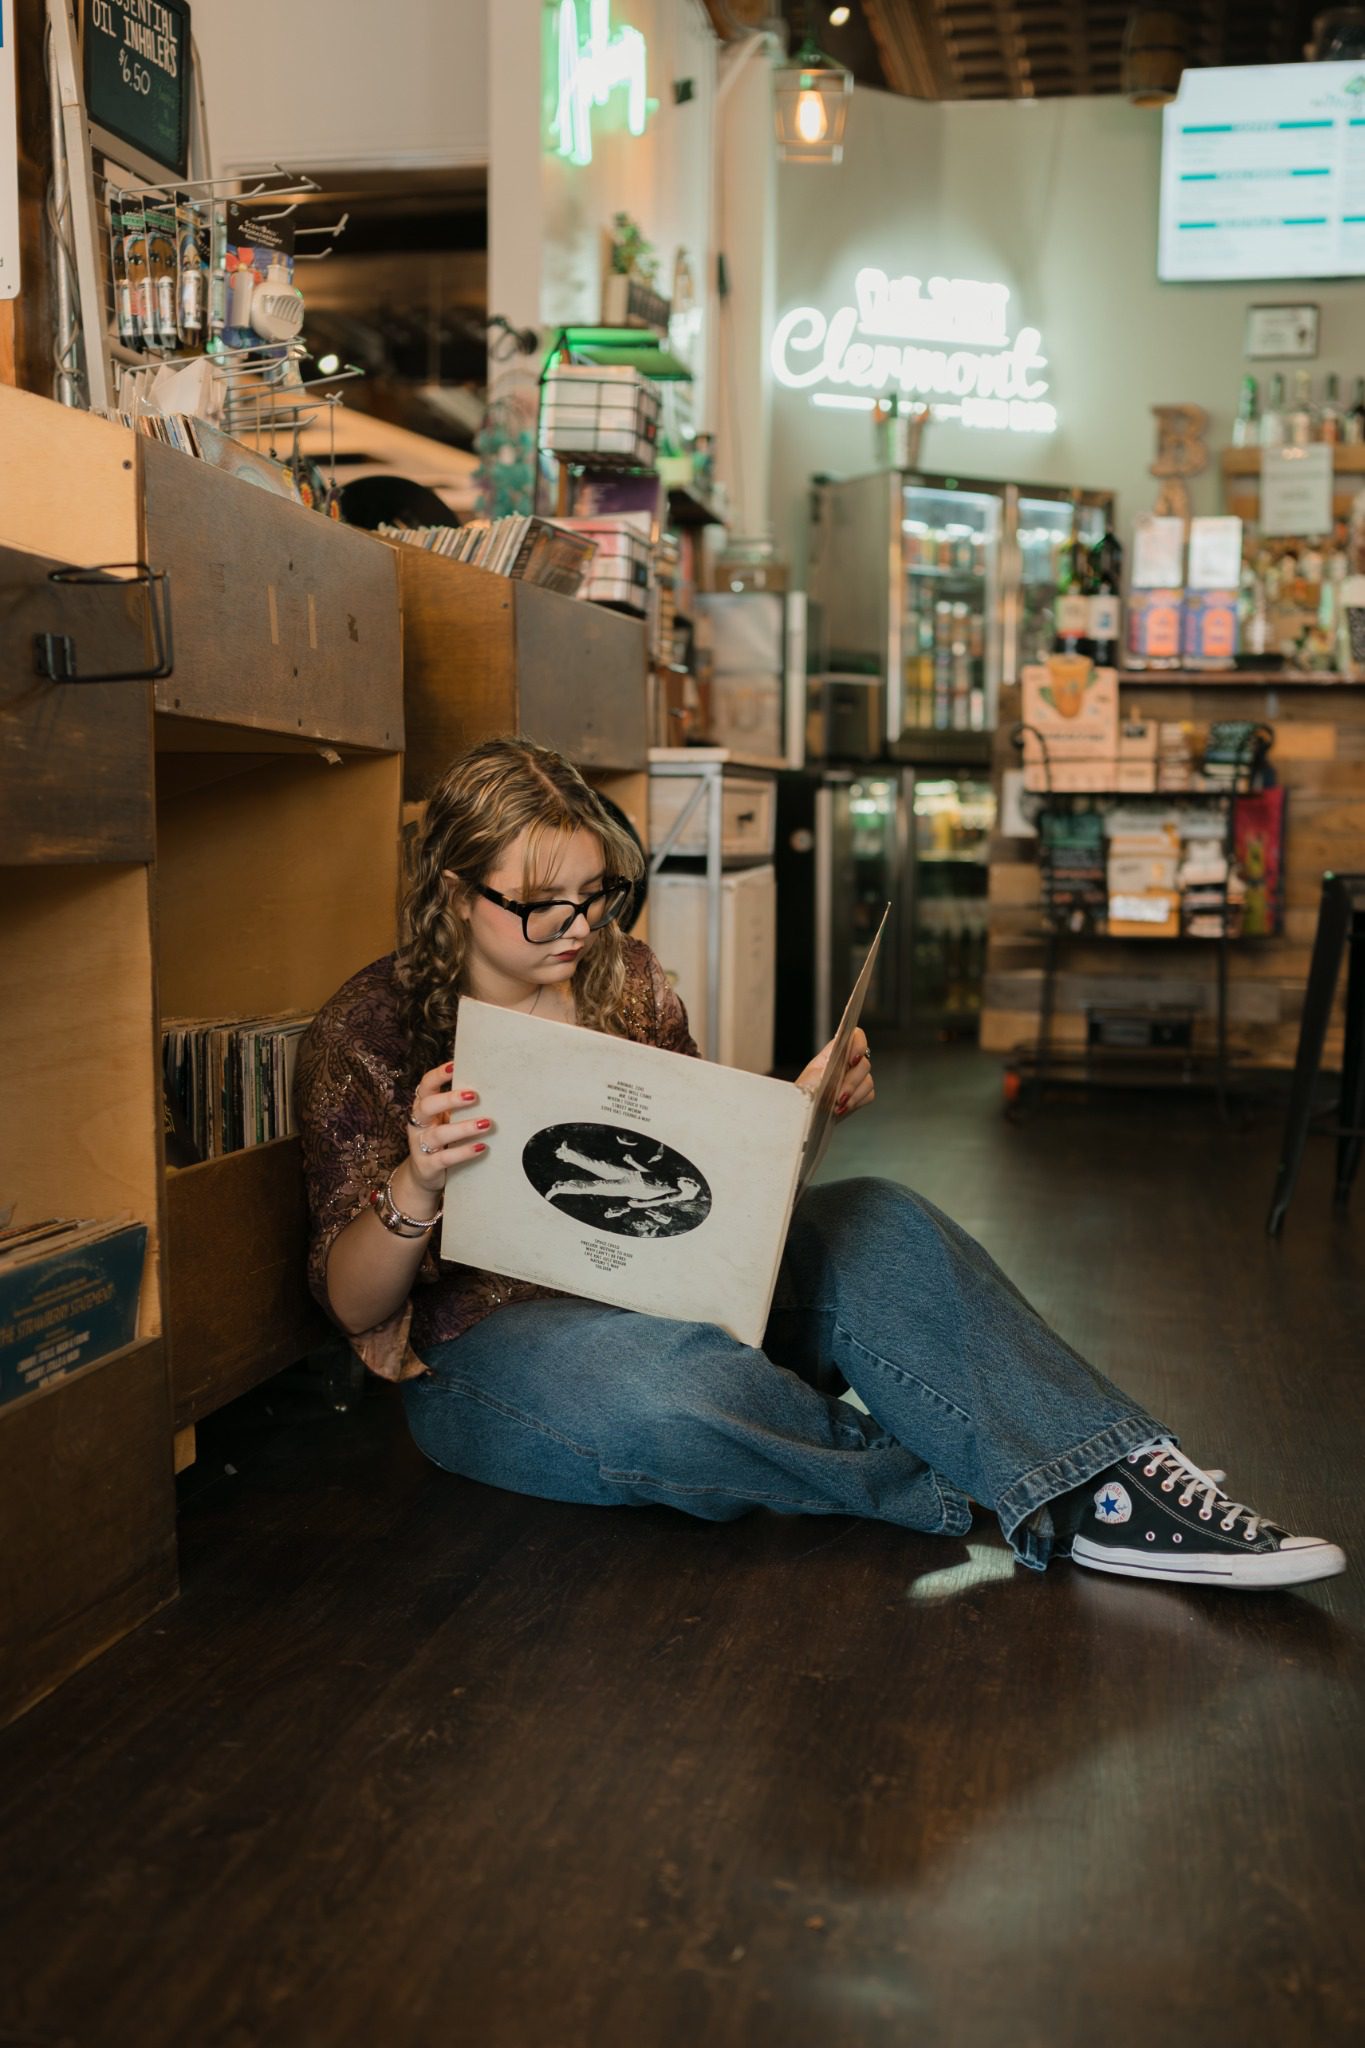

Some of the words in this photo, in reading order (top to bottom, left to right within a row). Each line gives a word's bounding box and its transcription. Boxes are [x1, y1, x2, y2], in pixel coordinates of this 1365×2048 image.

[92, 0, 117, 38] OIL
[123, 15, 177, 78] INHALERS
[118, 48, 151, 95] $6.50
[771, 306, 1050, 400] Clermont
